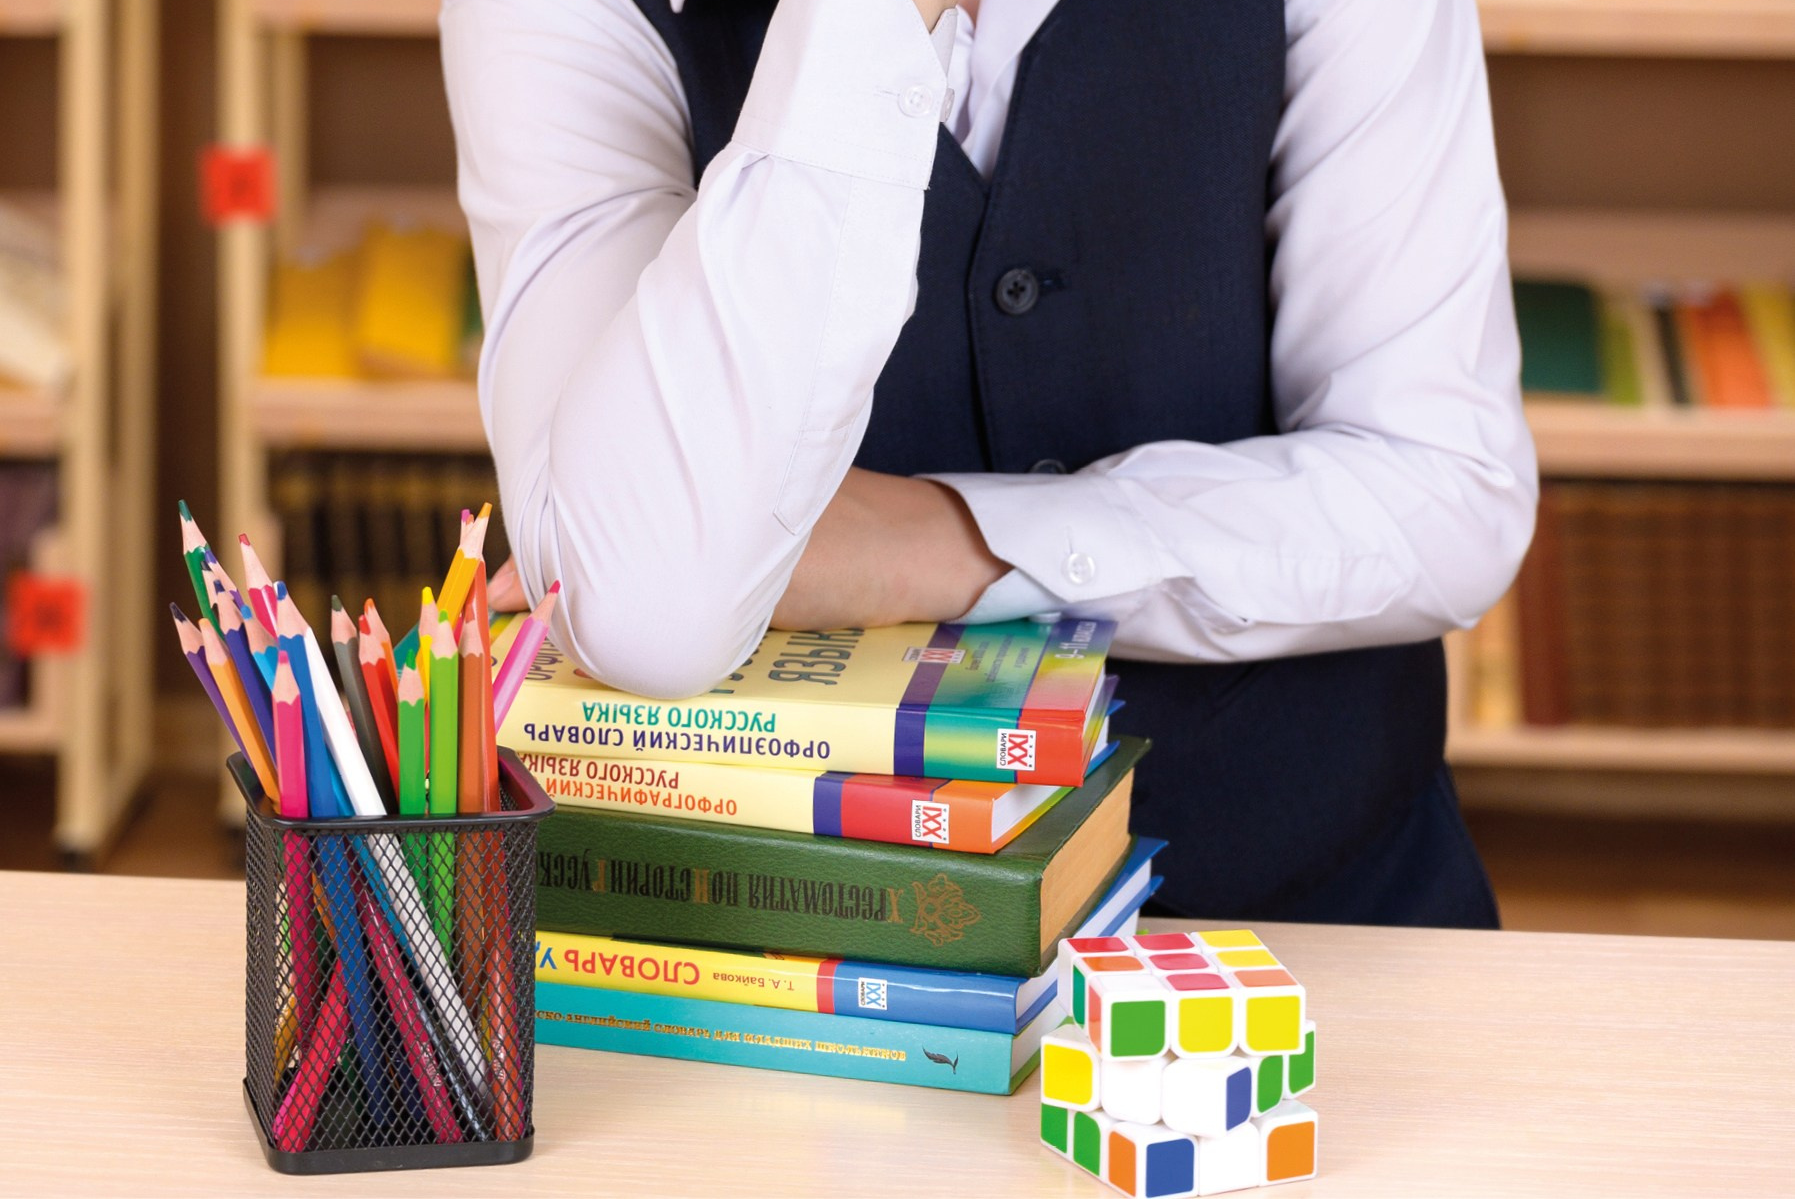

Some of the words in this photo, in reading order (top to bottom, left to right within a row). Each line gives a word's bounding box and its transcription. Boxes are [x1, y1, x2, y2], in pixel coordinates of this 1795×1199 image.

[582, 702, 661, 727] ЯЗЫКА
[667, 706, 776, 733] РУССКОГО
[524, 723, 624, 748] СЛОВАРЬ
[633, 729, 830, 760] ОРФОЭПИЧЕСКИЙ
[1008, 733, 1028, 767] XXI
[586, 761, 679, 789] РУССКОГО
[545, 777, 737, 816] ОРФОГРАФИЧЕСКИЙ
[922, 806, 942, 839] XXI
[747, 873, 904, 923] ХРЕСТОМАТИЯ
[564, 949, 701, 986] СЛОВАРЬ
[712, 971, 765, 988] Байкова
[768, 978, 781, 989] А.
[783, 979, 795, 991] Т.
[653, 1023, 711, 1039] СЛОВАРЬ
